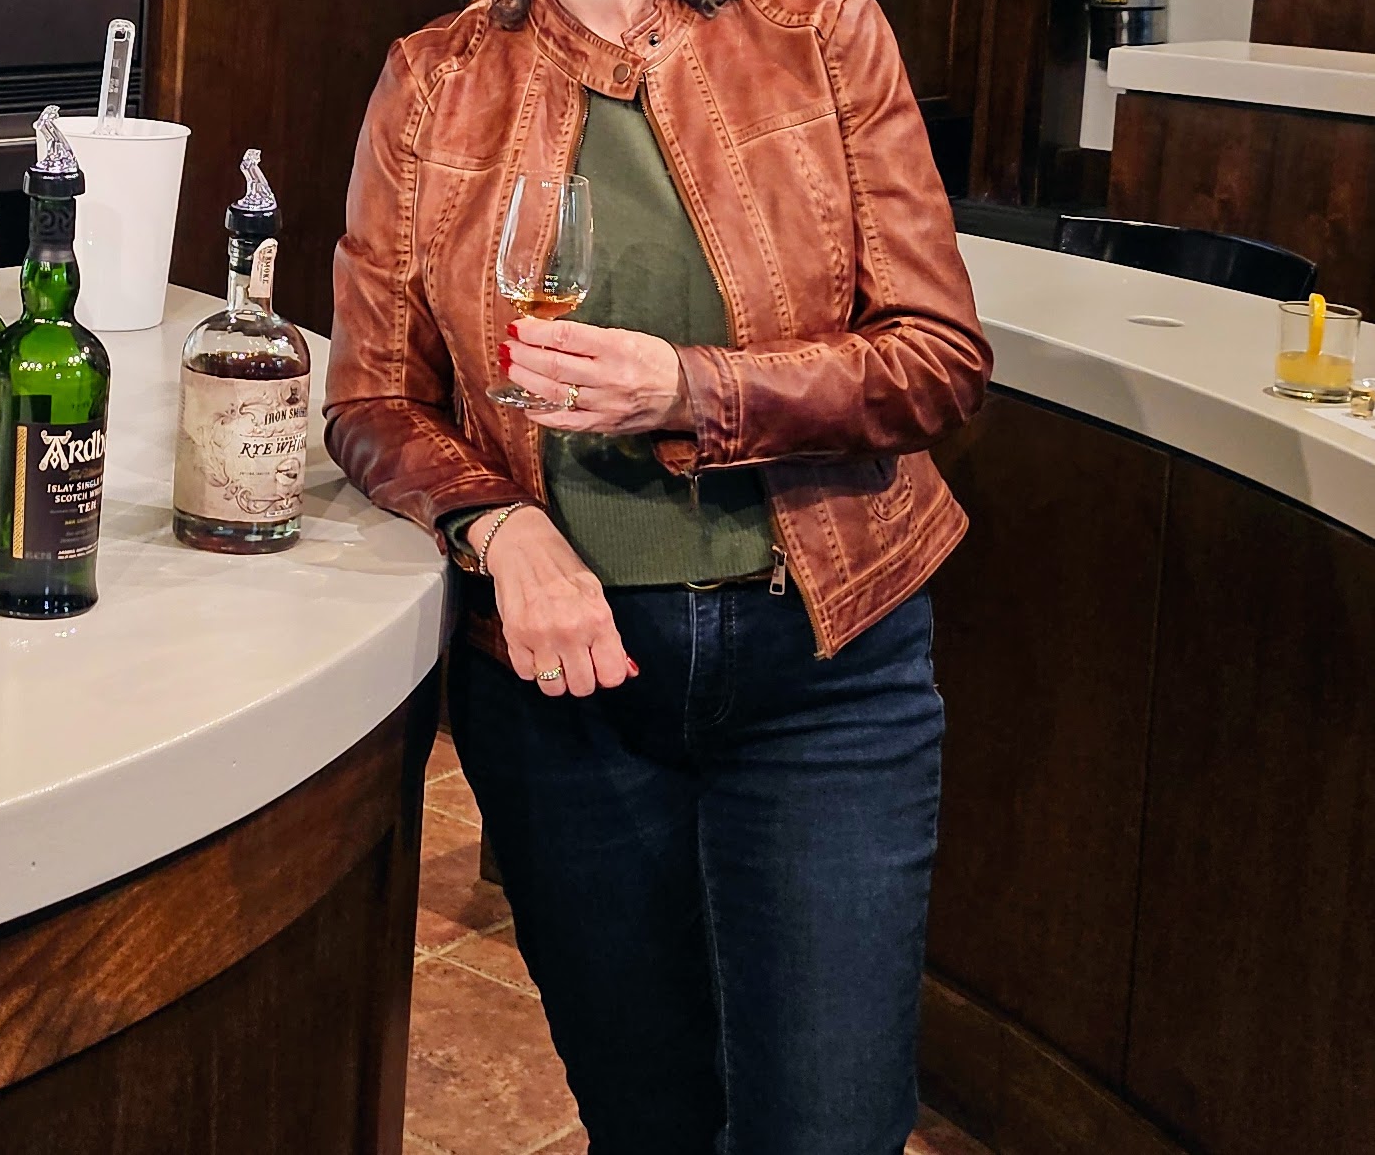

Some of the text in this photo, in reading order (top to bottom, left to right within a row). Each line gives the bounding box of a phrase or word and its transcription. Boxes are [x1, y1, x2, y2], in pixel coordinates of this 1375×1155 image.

[264, 409, 287, 425] IRON
[38, 429, 106, 471] Ardb
[240, 442, 273, 458] RYE
[276, 436, 306, 454] WHIS
[47, 483, 75, 493] ISLAY
[54, 491, 88, 504] SCOTCH
[78, 500, 97, 514] TEN
